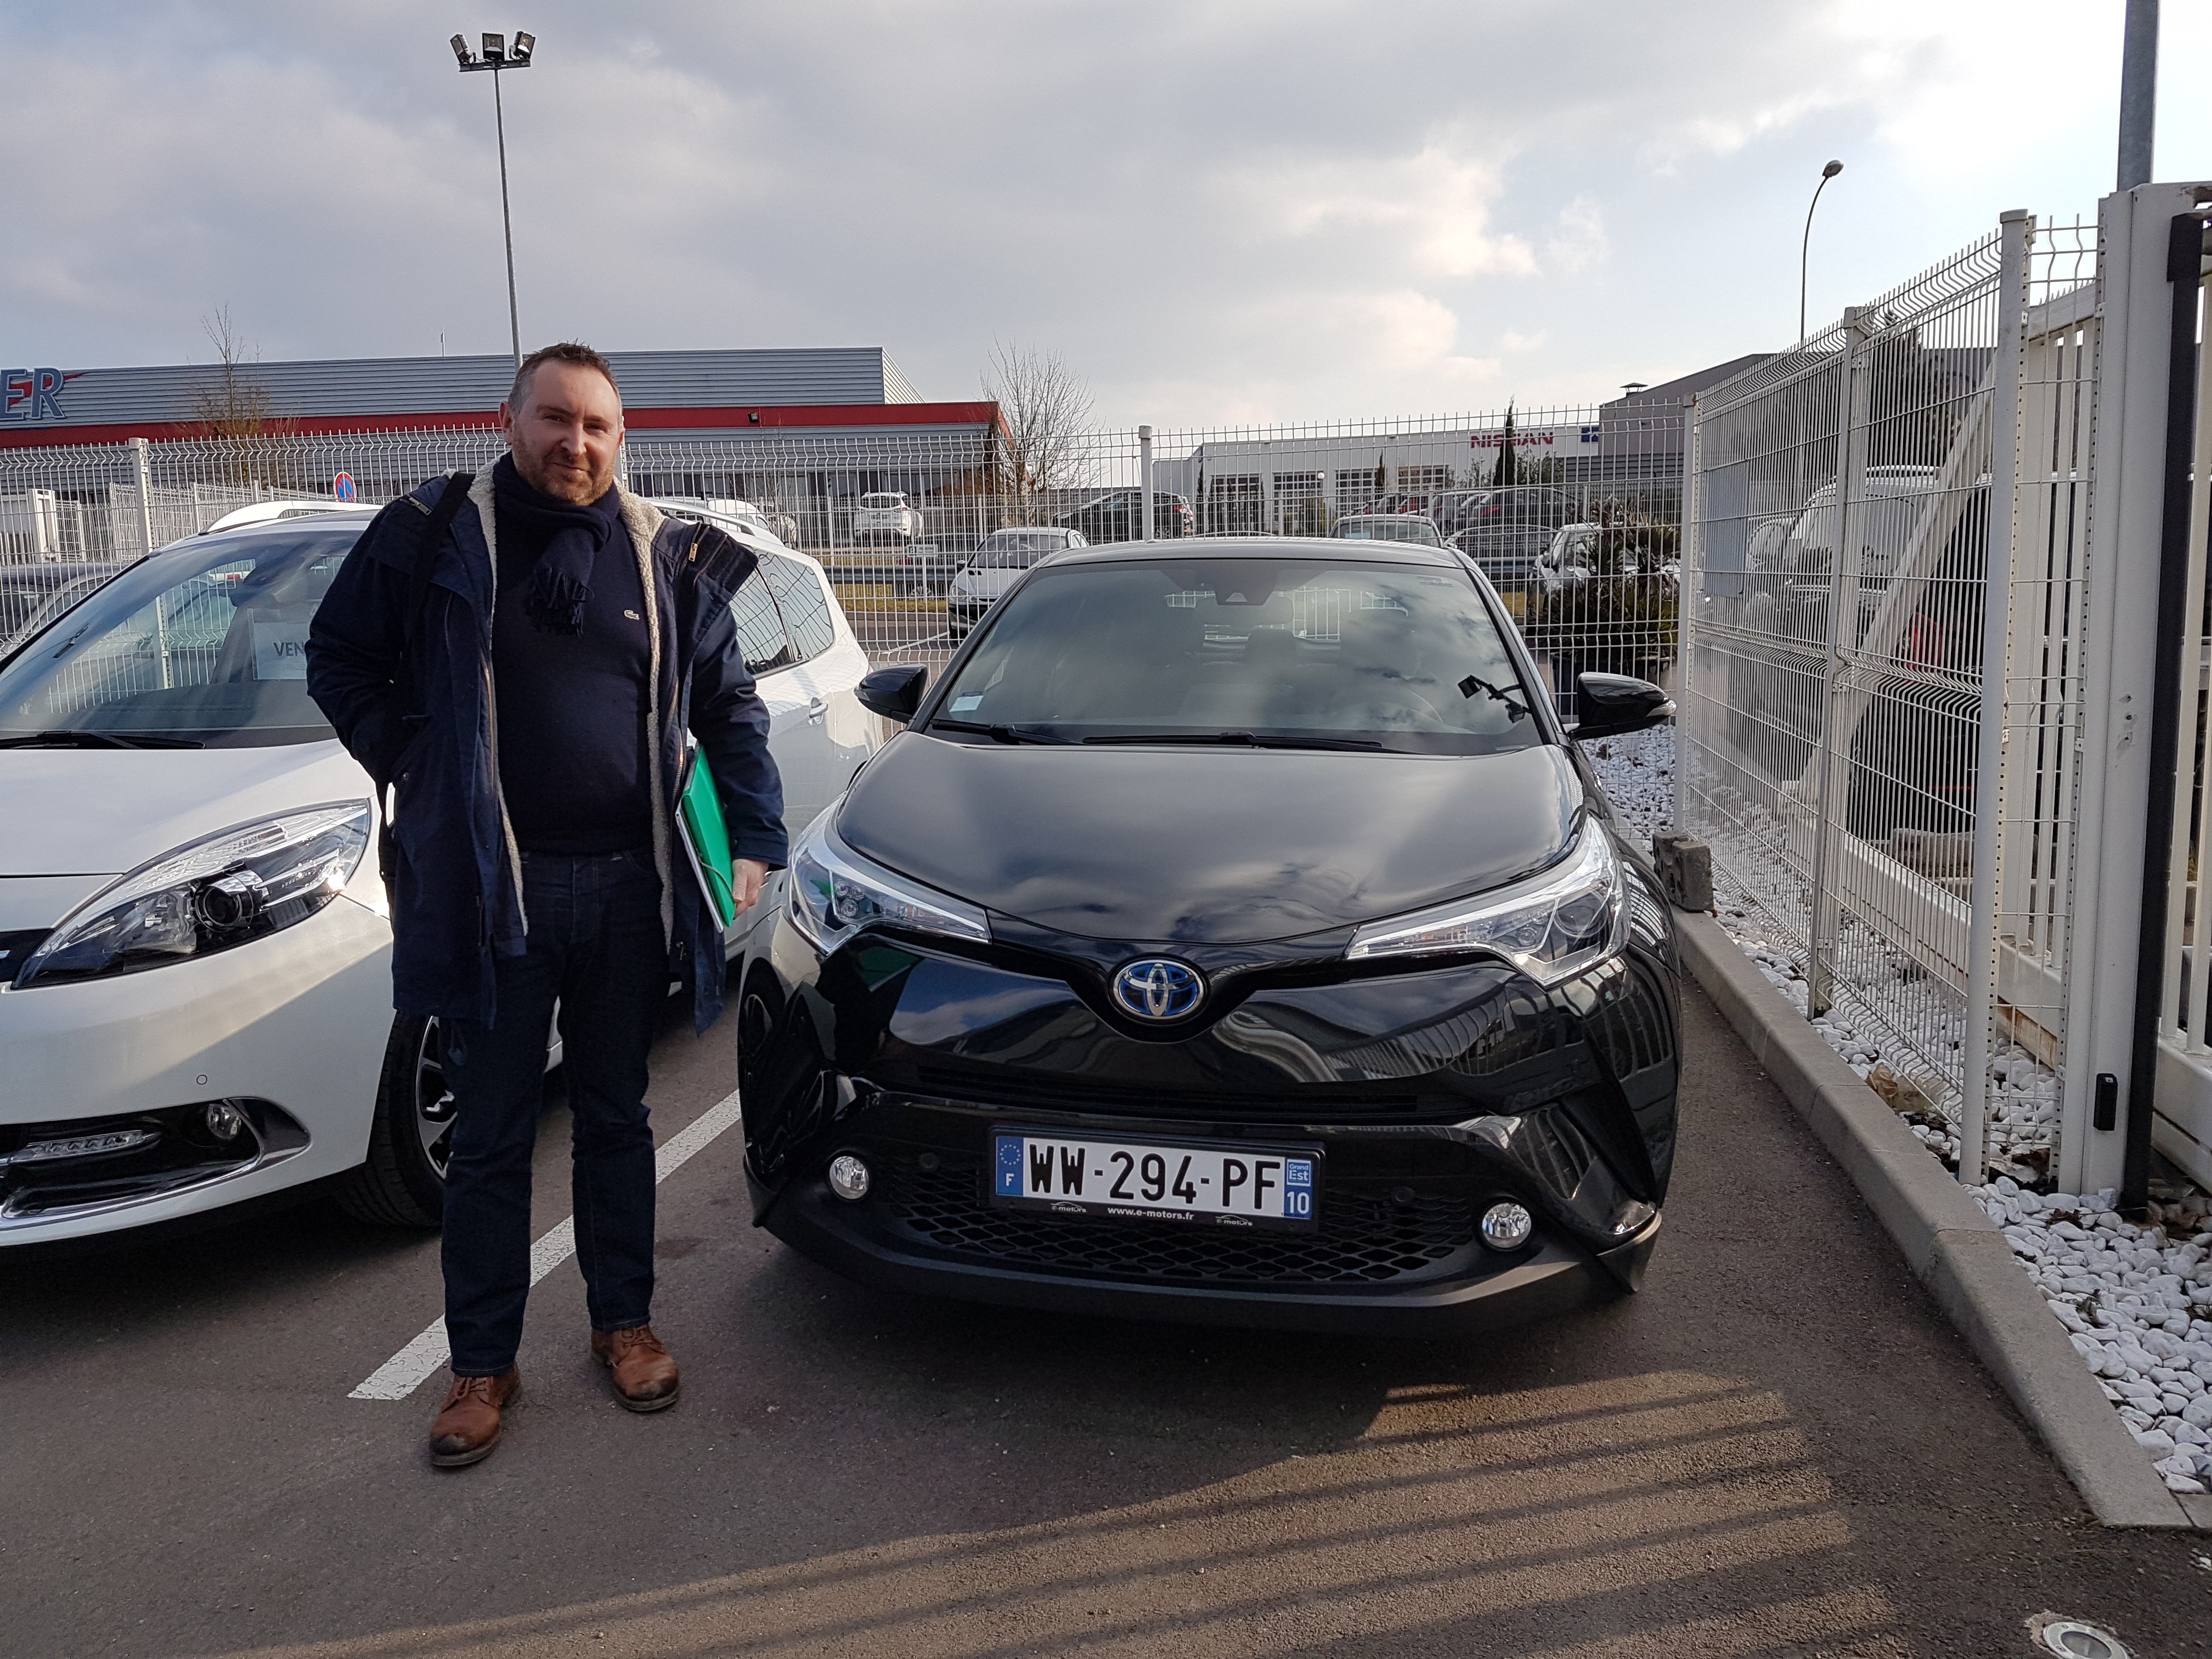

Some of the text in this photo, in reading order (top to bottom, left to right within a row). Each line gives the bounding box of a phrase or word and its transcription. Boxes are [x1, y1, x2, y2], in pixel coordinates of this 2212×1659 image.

[0, 366, 65, 419] ER
[1471, 432, 1553, 448] NISSAN
[1006, 1173, 1014, 1186] F
[1289, 1170, 1308, 1181] Est
[1287, 1191, 1310, 1214] 10
[1107, 1207, 1194, 1220] www.e-motors.fr
